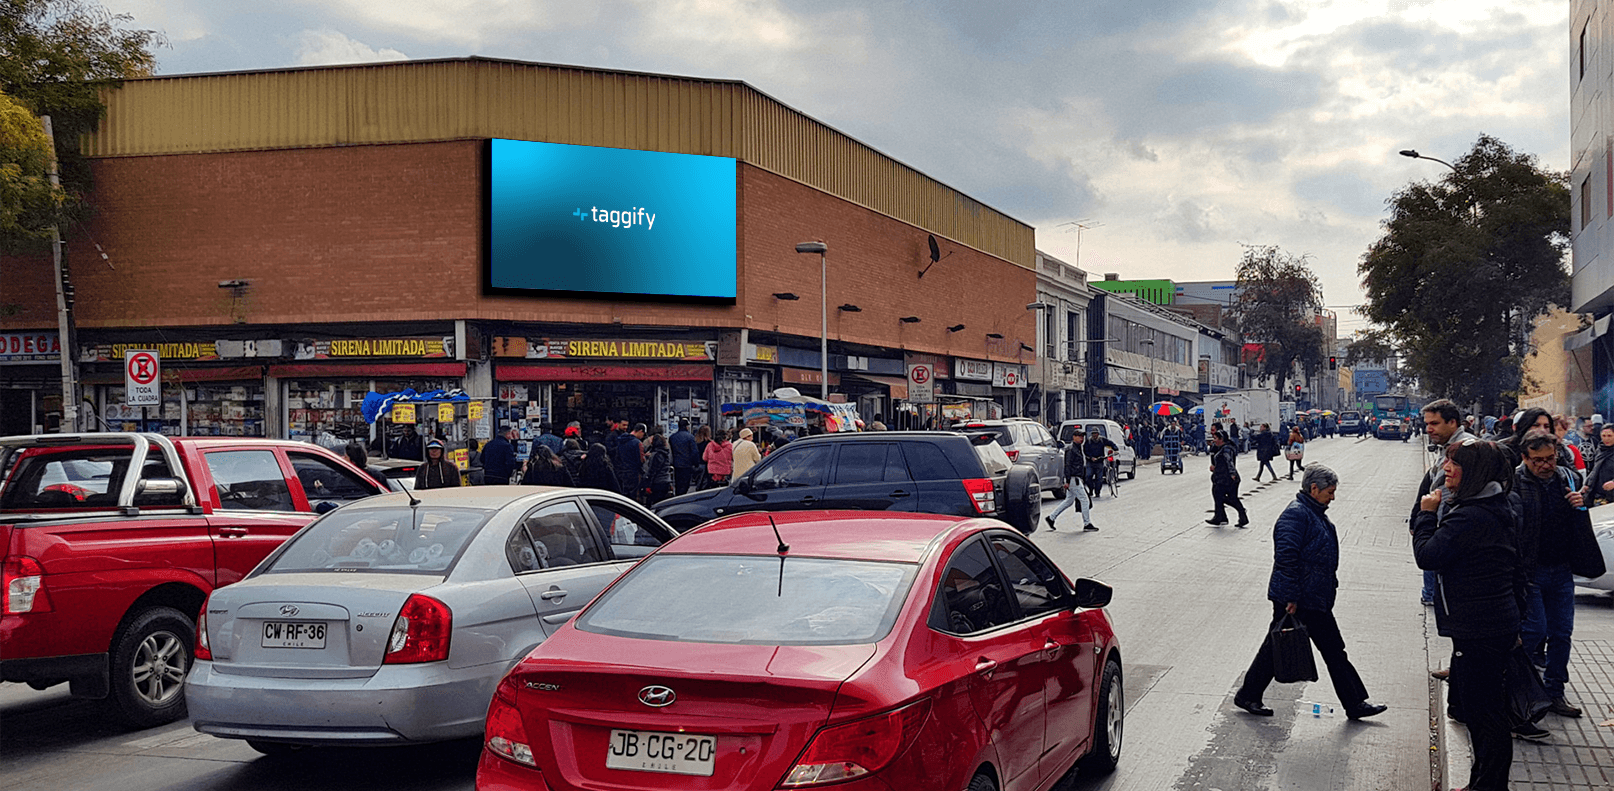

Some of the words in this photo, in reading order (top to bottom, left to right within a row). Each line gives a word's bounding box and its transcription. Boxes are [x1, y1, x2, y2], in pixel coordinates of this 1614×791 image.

[591, 206, 656, 231] taggify
[331, 340, 369, 356] SIRENA
[373, 340, 426, 356] LIMITADA
[569, 341, 619, 357] SIRENA
[621, 342, 686, 358] LIMITADA
